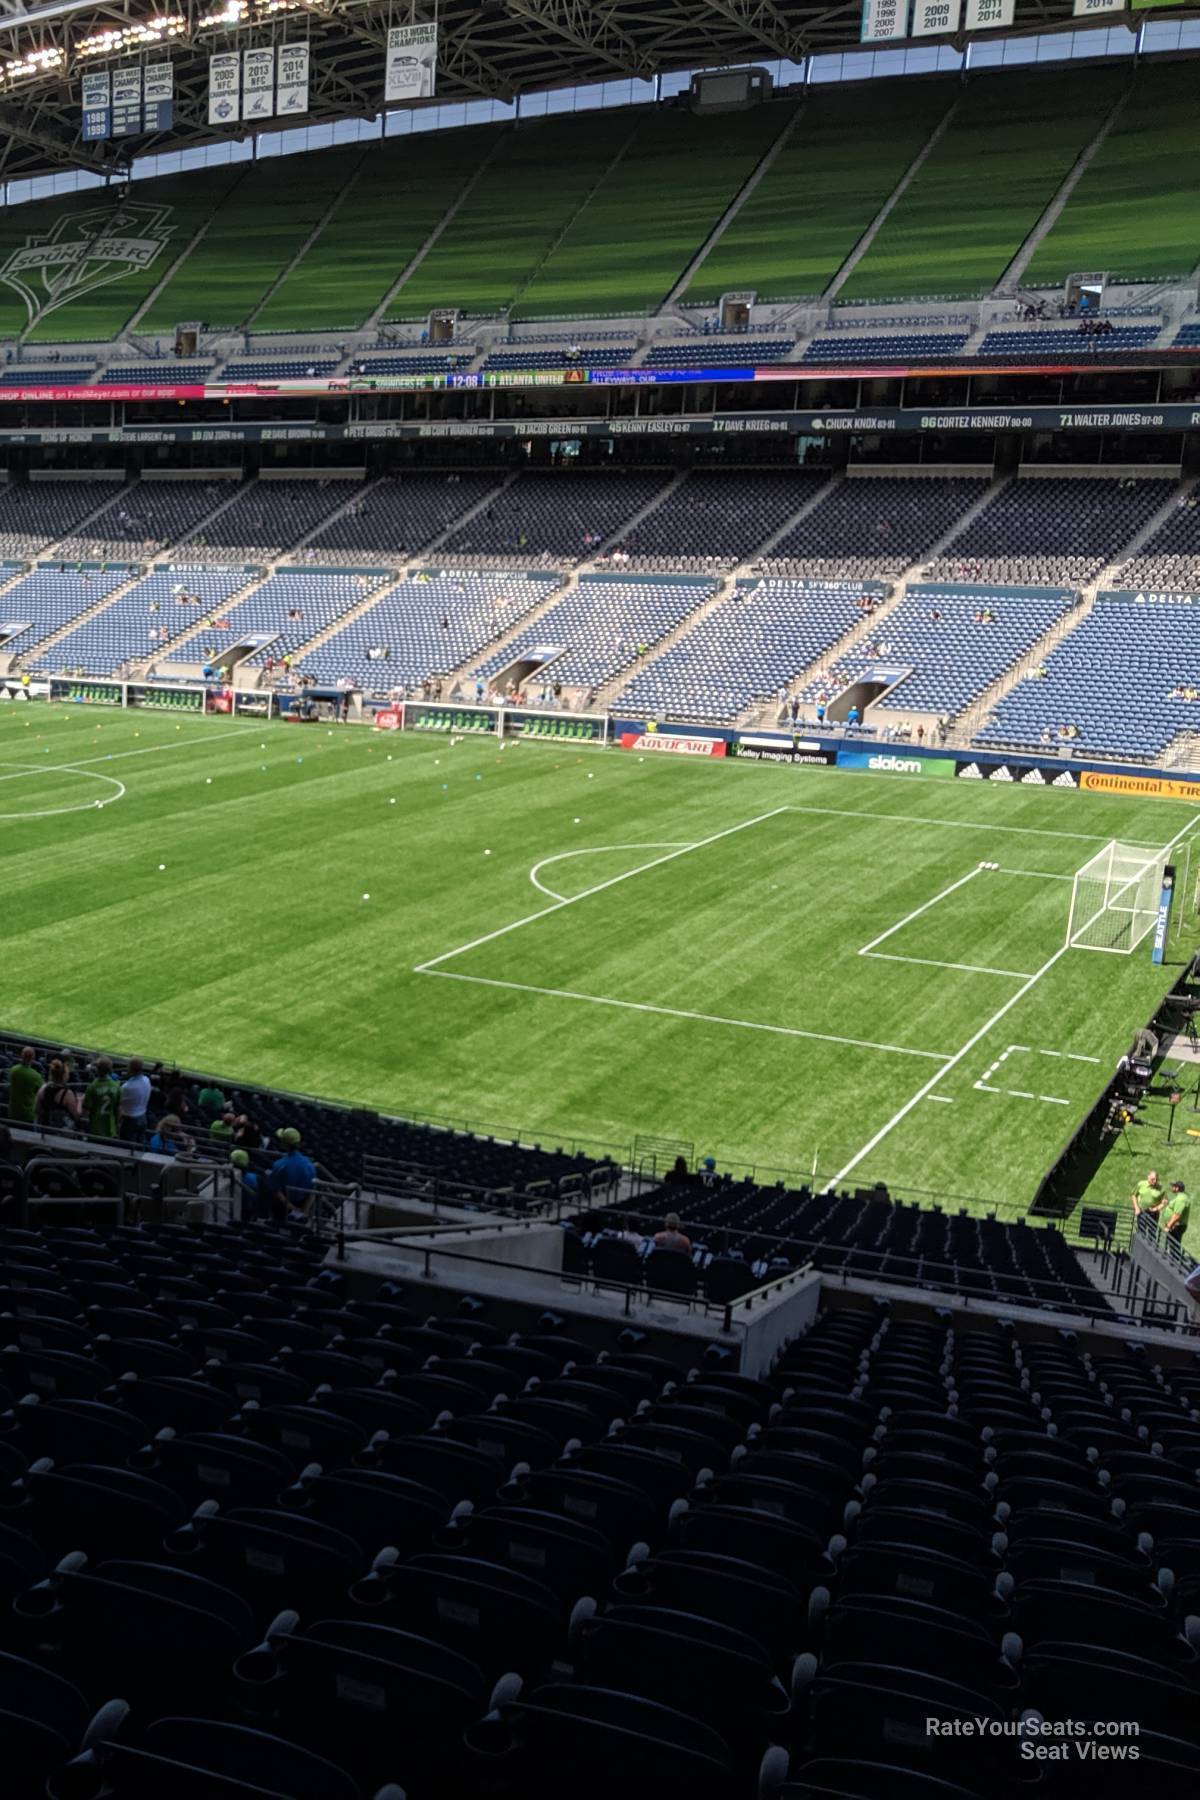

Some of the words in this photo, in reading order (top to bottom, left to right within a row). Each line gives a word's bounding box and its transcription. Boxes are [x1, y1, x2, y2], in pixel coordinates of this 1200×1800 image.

[876, 9, 896, 18] 1996
[924, 4, 950, 16] 2009
[978, 10, 1002, 22] 2014
[875, 18, 895, 28] 2005
[924, 16, 948, 28] 2010
[390, 30, 408, 40] 2013
[410, 25, 435, 36] WORLD
[874, 28, 894, 37] 2007
[390, 34, 435, 48] CHAMPIONS
[248, 65, 269, 77] 2013
[283, 60, 304, 72] 2014
[214, 70, 234, 81] 2005
[286, 72, 300, 80] NFC
[217, 81, 232, 90] NFC
[251, 77, 266, 86] NFC
[126, 250, 150, 260] FC
[416, 379, 425, 389] FC
[453, 376, 478, 388] 12:08
[500, 375, 533, 386] ATLANTA
[535, 375, 564, 384] UNITED
[22, 392, 53, 400] ONLINE
[713, 420, 724, 431] 17
[725, 420, 744, 431] DAVE
[745, 420, 770, 430] KRIEG
[825, 419, 853, 429] CHUCK
[854, 418, 877, 429] KNOX
[921, 417, 936, 428] 96
[937, 416, 969, 428] CORTEZ
[971, 416, 1010, 428] KENNEDY
[1060, 415, 1073, 426] 71
[1074, 414, 1110, 426] WALTER
[1111, 414, 1141, 425] JONES
[350, 426, 364, 437] PETE
[514, 424, 525, 435] 79
[526, 424, 547, 434] JACOB
[550, 424, 571, 433] GREEN
[608, 422, 622, 432] 45
[622, 422, 646, 432] KENNY
[648, 422, 674, 432] EASLEY
[137, 432, 162, 441] LARGENT
[769, 579, 804, 589] DELTA
[1149, 594, 1192, 604] DELTA
[635, 738, 712, 753] ADVOCARE
[737, 750, 766, 760] Kelley
[768, 751, 792, 763] Imaging
[794, 753, 827, 764] Systems
[869, 755, 921, 773] slalom
[1086, 774, 1161, 792] Continental
[1155, 906, 1167, 948] SEATTLE
